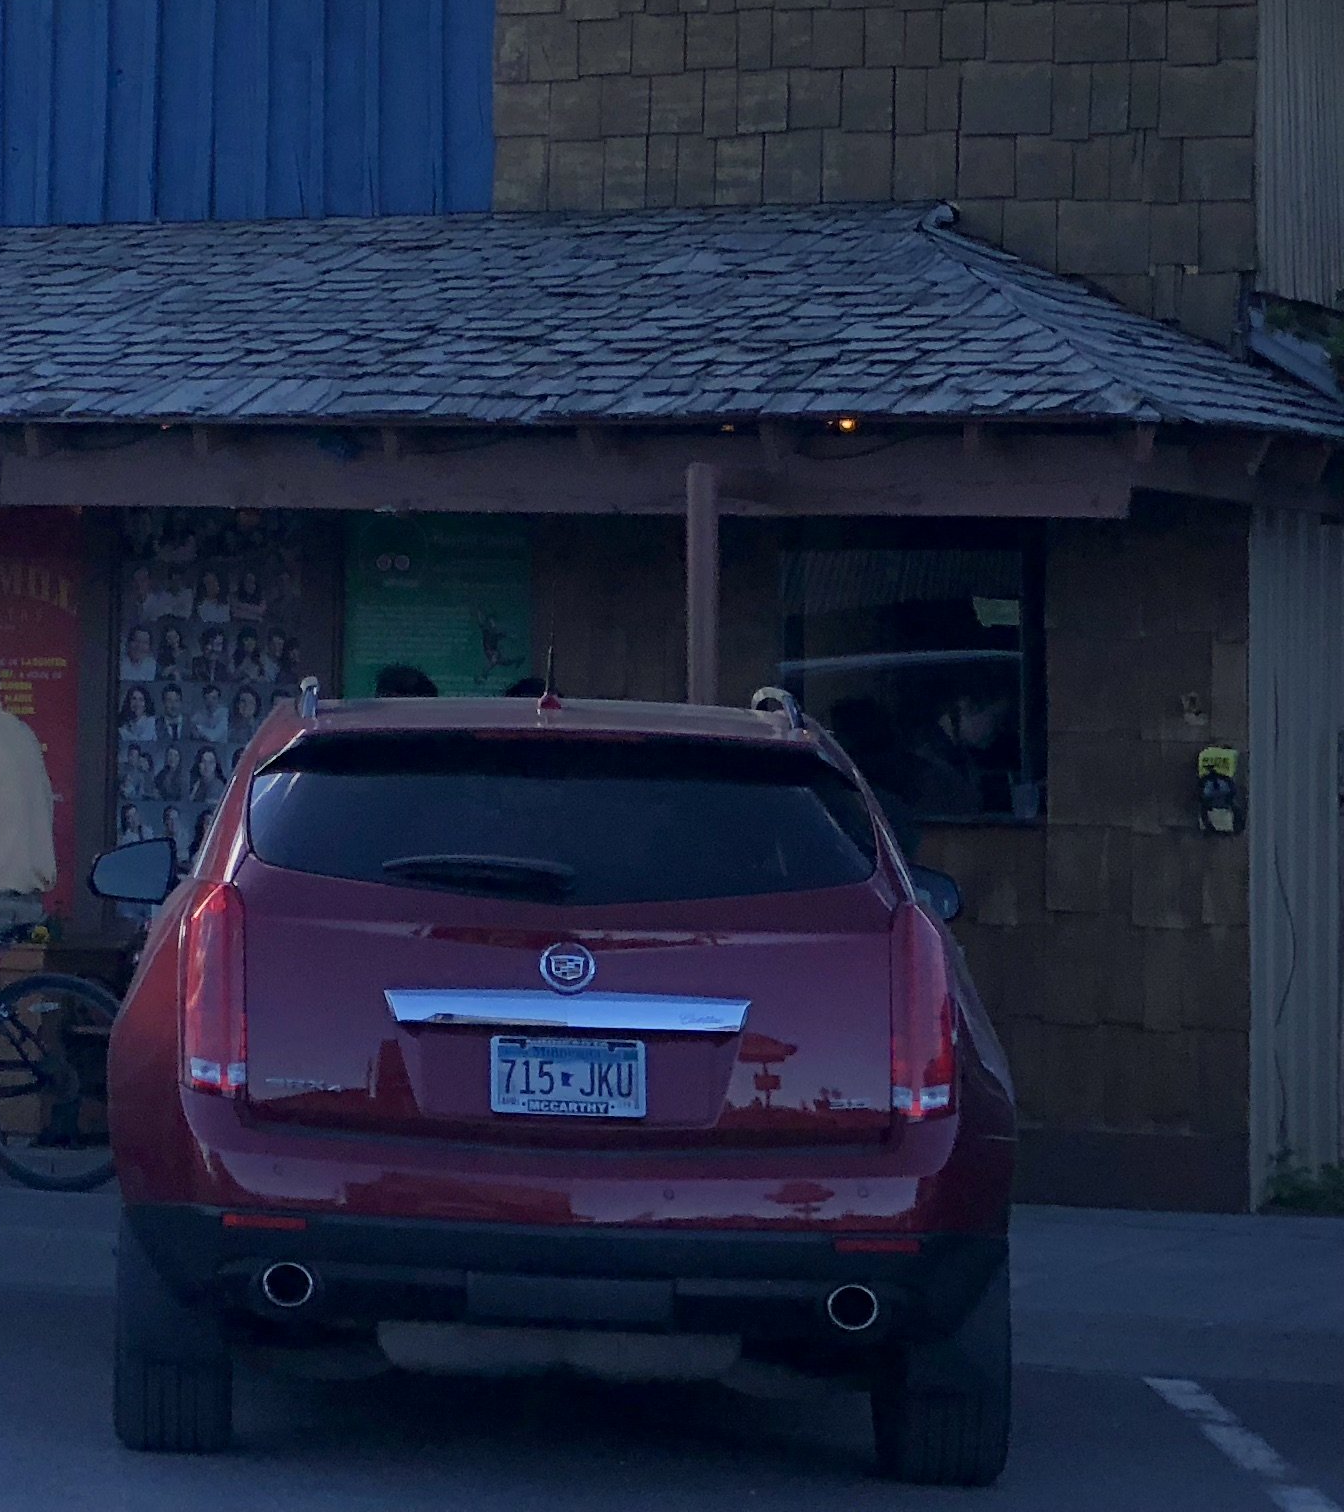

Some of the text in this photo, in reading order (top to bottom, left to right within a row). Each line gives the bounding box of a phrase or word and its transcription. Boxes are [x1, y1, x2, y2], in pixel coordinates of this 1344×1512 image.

[500, 1059, 633, 1098] 715 JKU
[528, 1100, 607, 1113] MCCARTHY
